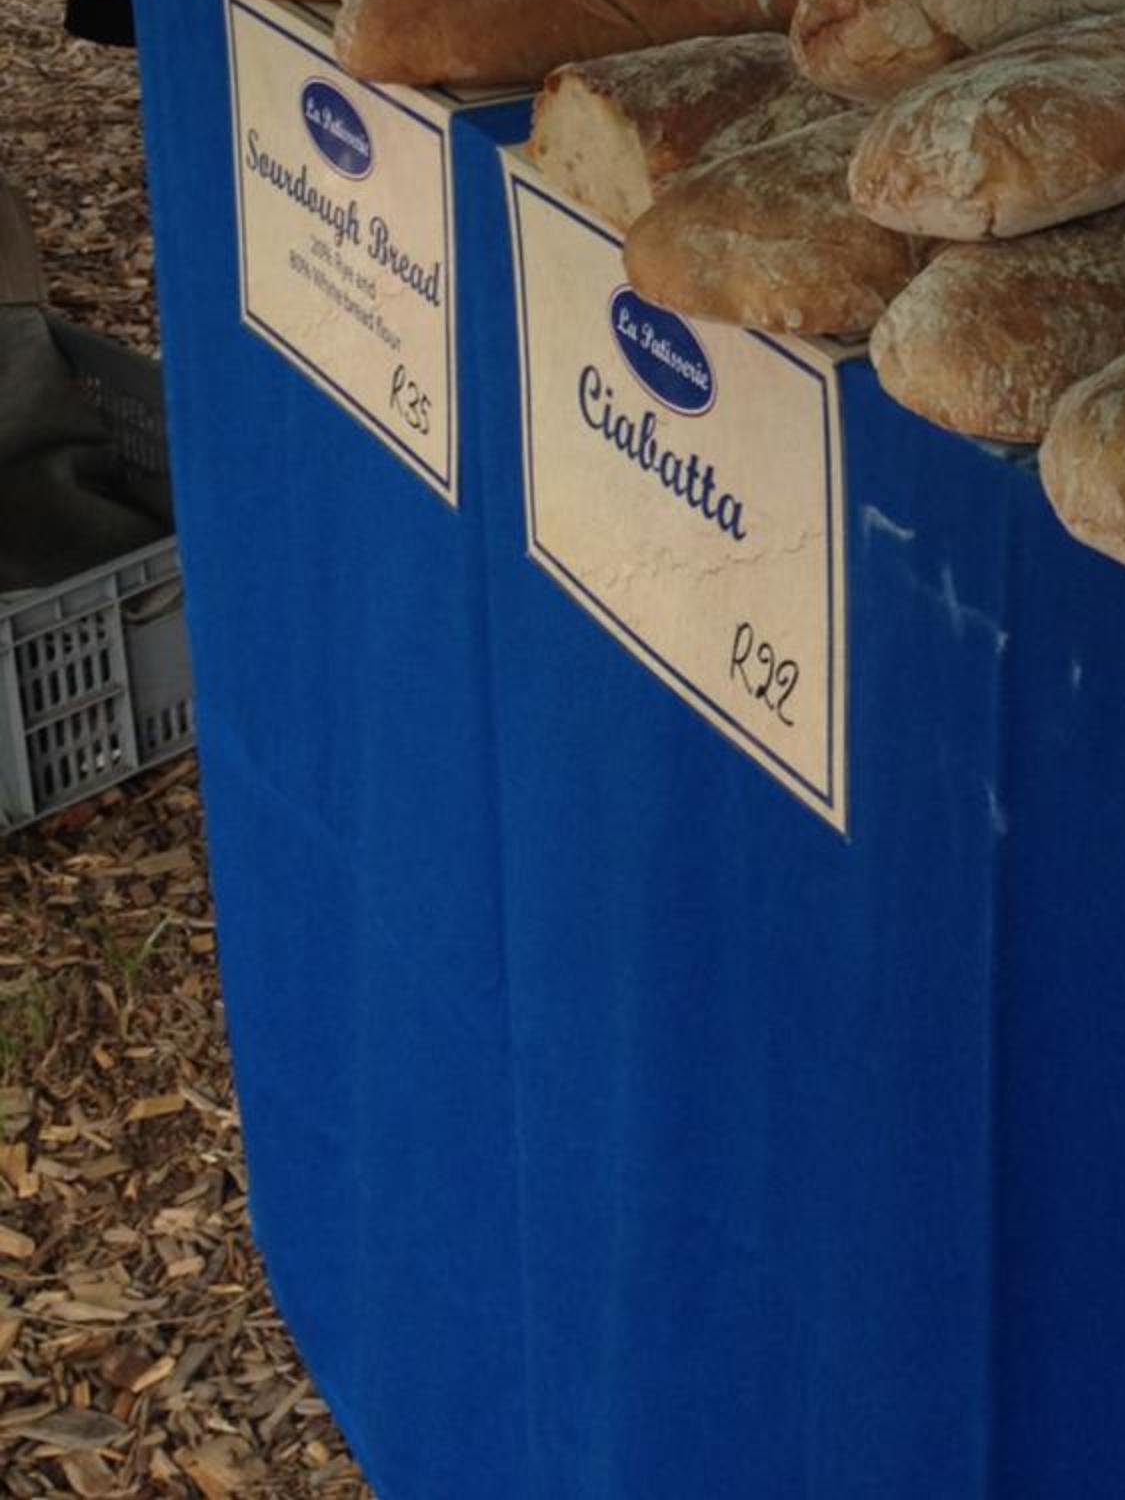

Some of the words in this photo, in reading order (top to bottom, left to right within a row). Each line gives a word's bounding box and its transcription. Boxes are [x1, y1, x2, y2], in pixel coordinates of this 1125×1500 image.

[245, 128, 361, 247] Sourdough
[369, 215, 442, 307] Bread
[356, 274, 376, 301] and
[617, 307, 638, 341] La
[640, 323, 709, 391] Patisserie
[389, 364, 431, 435] R35
[578, 364, 747, 540] Ciabatta
[729, 621, 800, 726] R22
